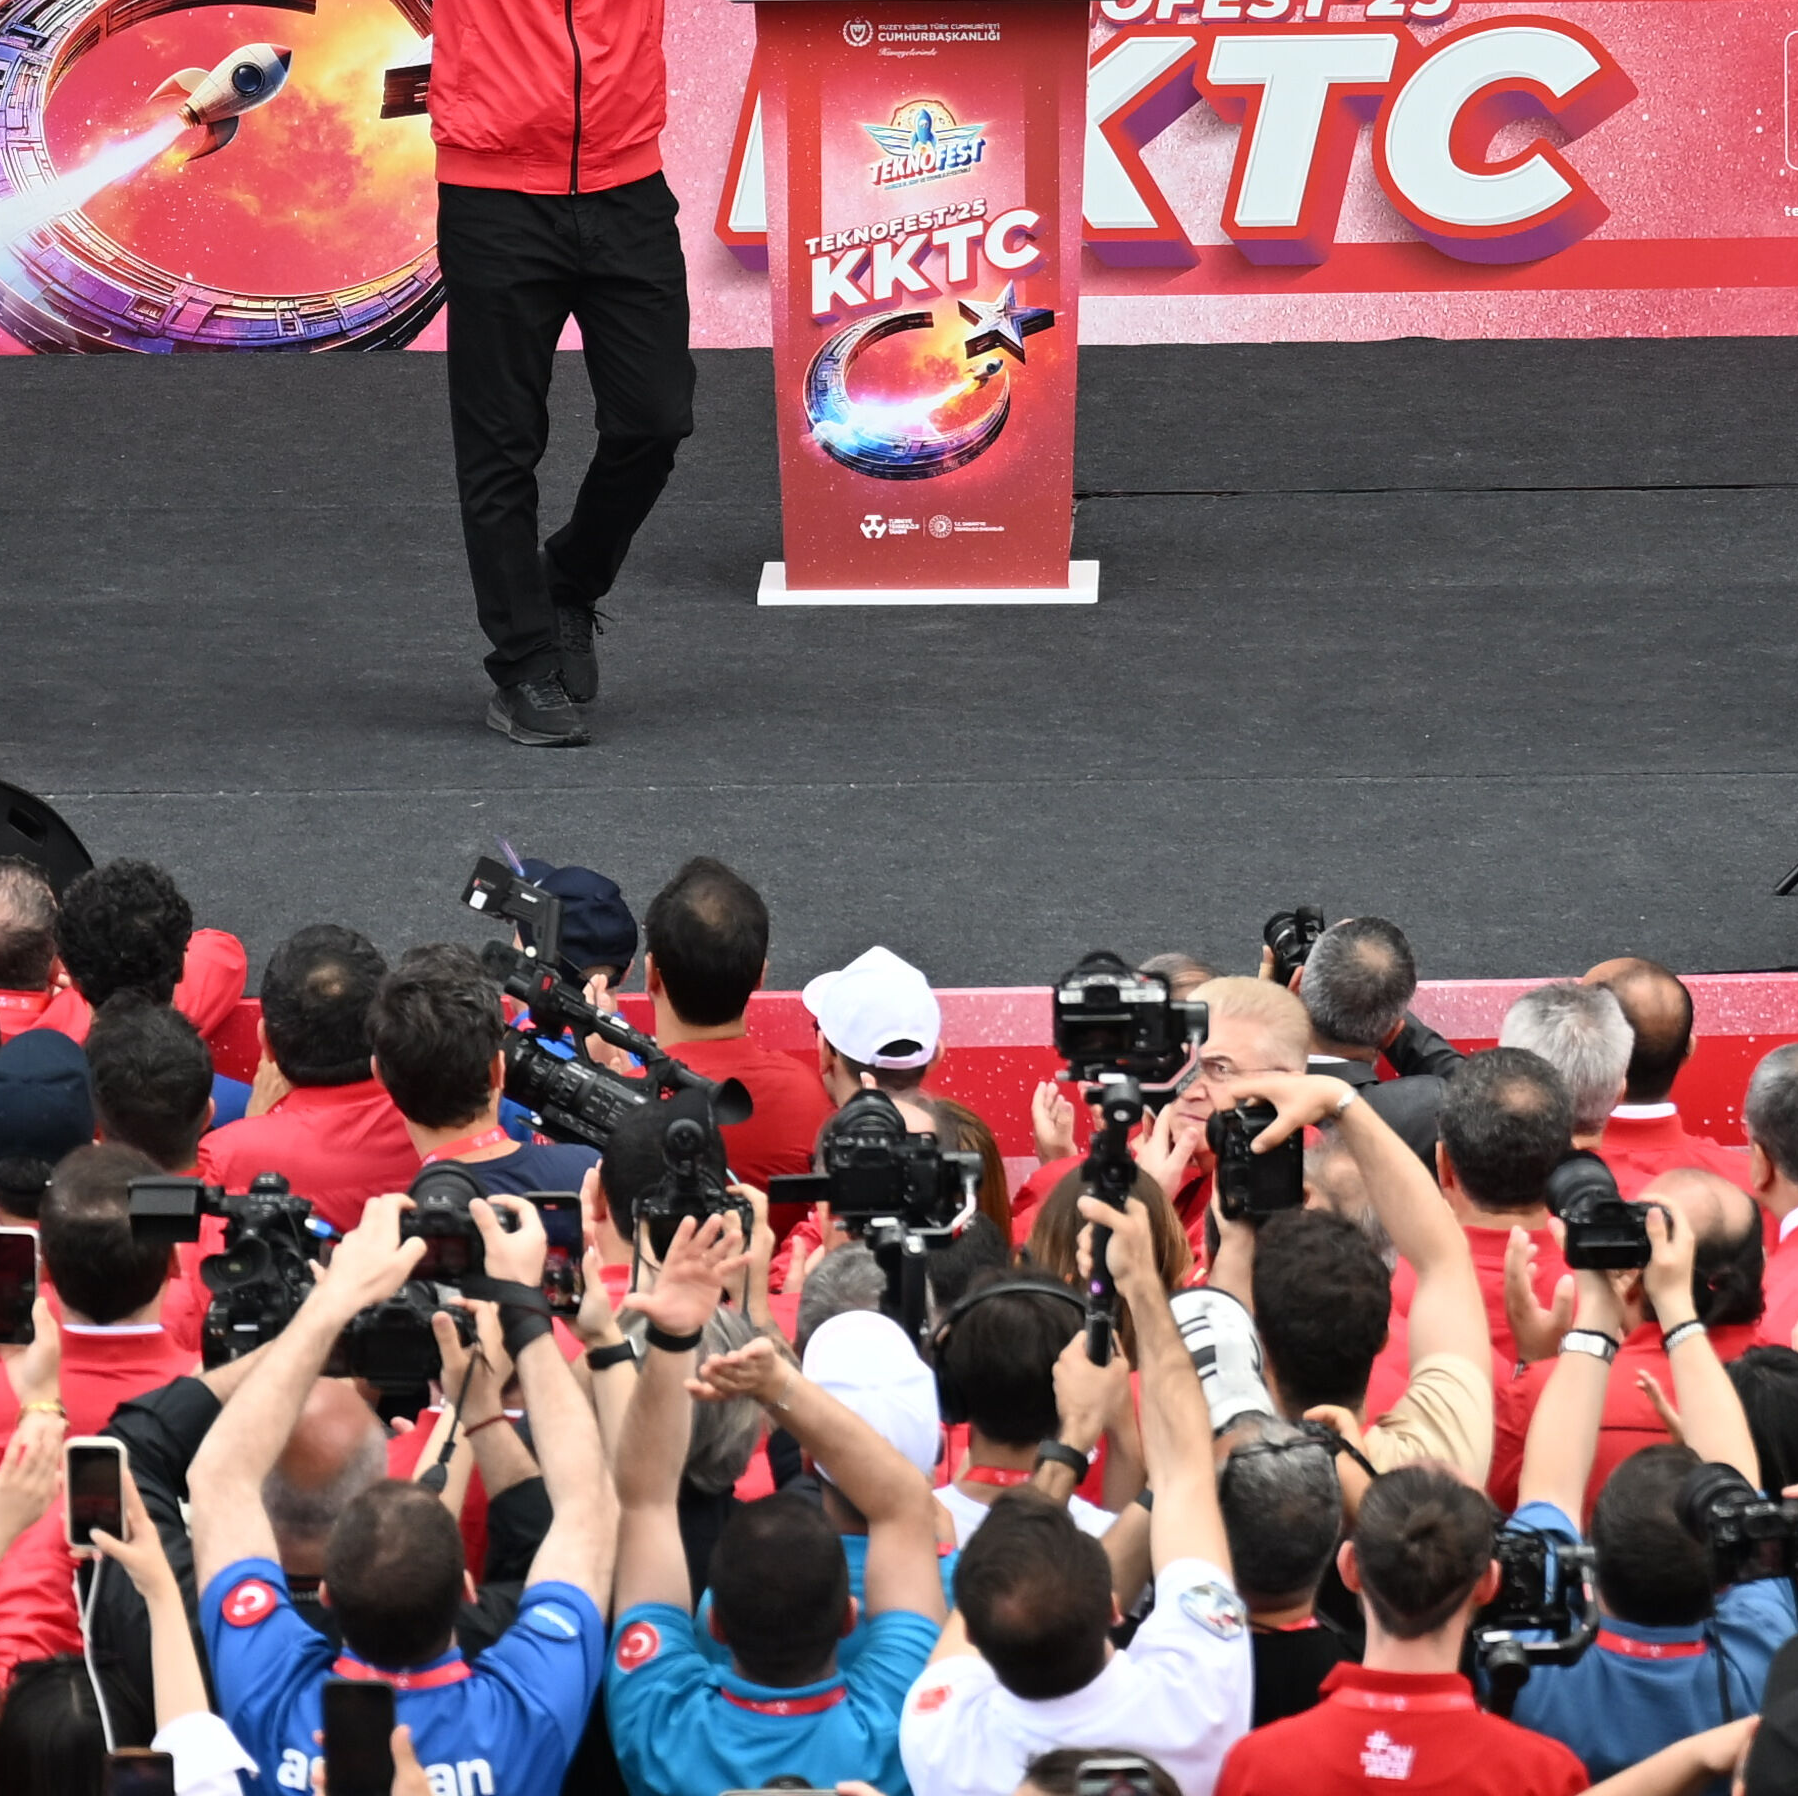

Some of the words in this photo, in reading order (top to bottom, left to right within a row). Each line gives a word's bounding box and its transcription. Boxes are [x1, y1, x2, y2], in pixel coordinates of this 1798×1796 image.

[877, 30, 1001, 43] CUMHURBAŞKANLIĞI
[870, 137, 986, 186] TEKNOFEST
[804, 198, 987, 256] TEKNOFEST'25
[810, 208, 1042, 315] KKTC
